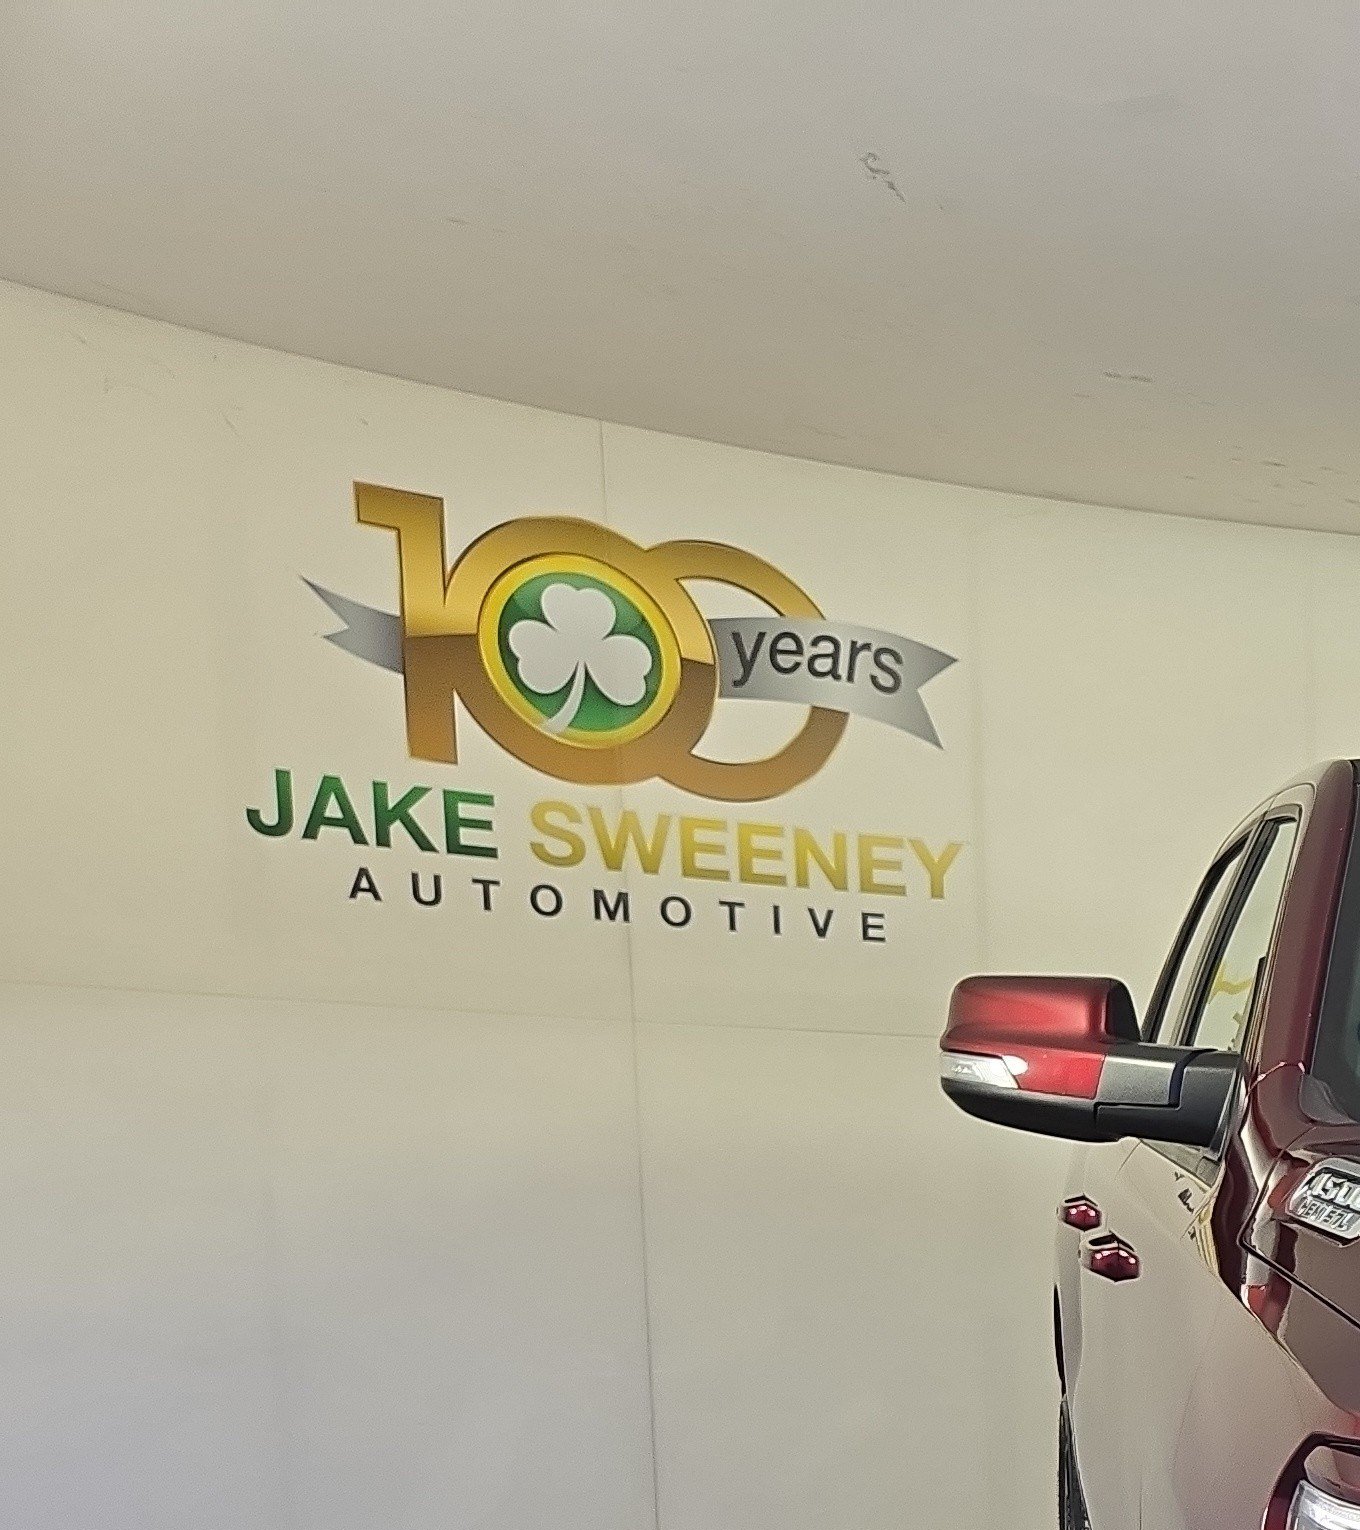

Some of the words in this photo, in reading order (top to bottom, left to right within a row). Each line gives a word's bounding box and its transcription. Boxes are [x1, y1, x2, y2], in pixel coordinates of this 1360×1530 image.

[352, 480, 849, 802] 100
[730, 623, 904, 694] years
[246, 768, 500, 860] JAKE
[529, 801, 964, 899] SWEENEY
[349, 867, 887, 942] AUTOMOTIVE
